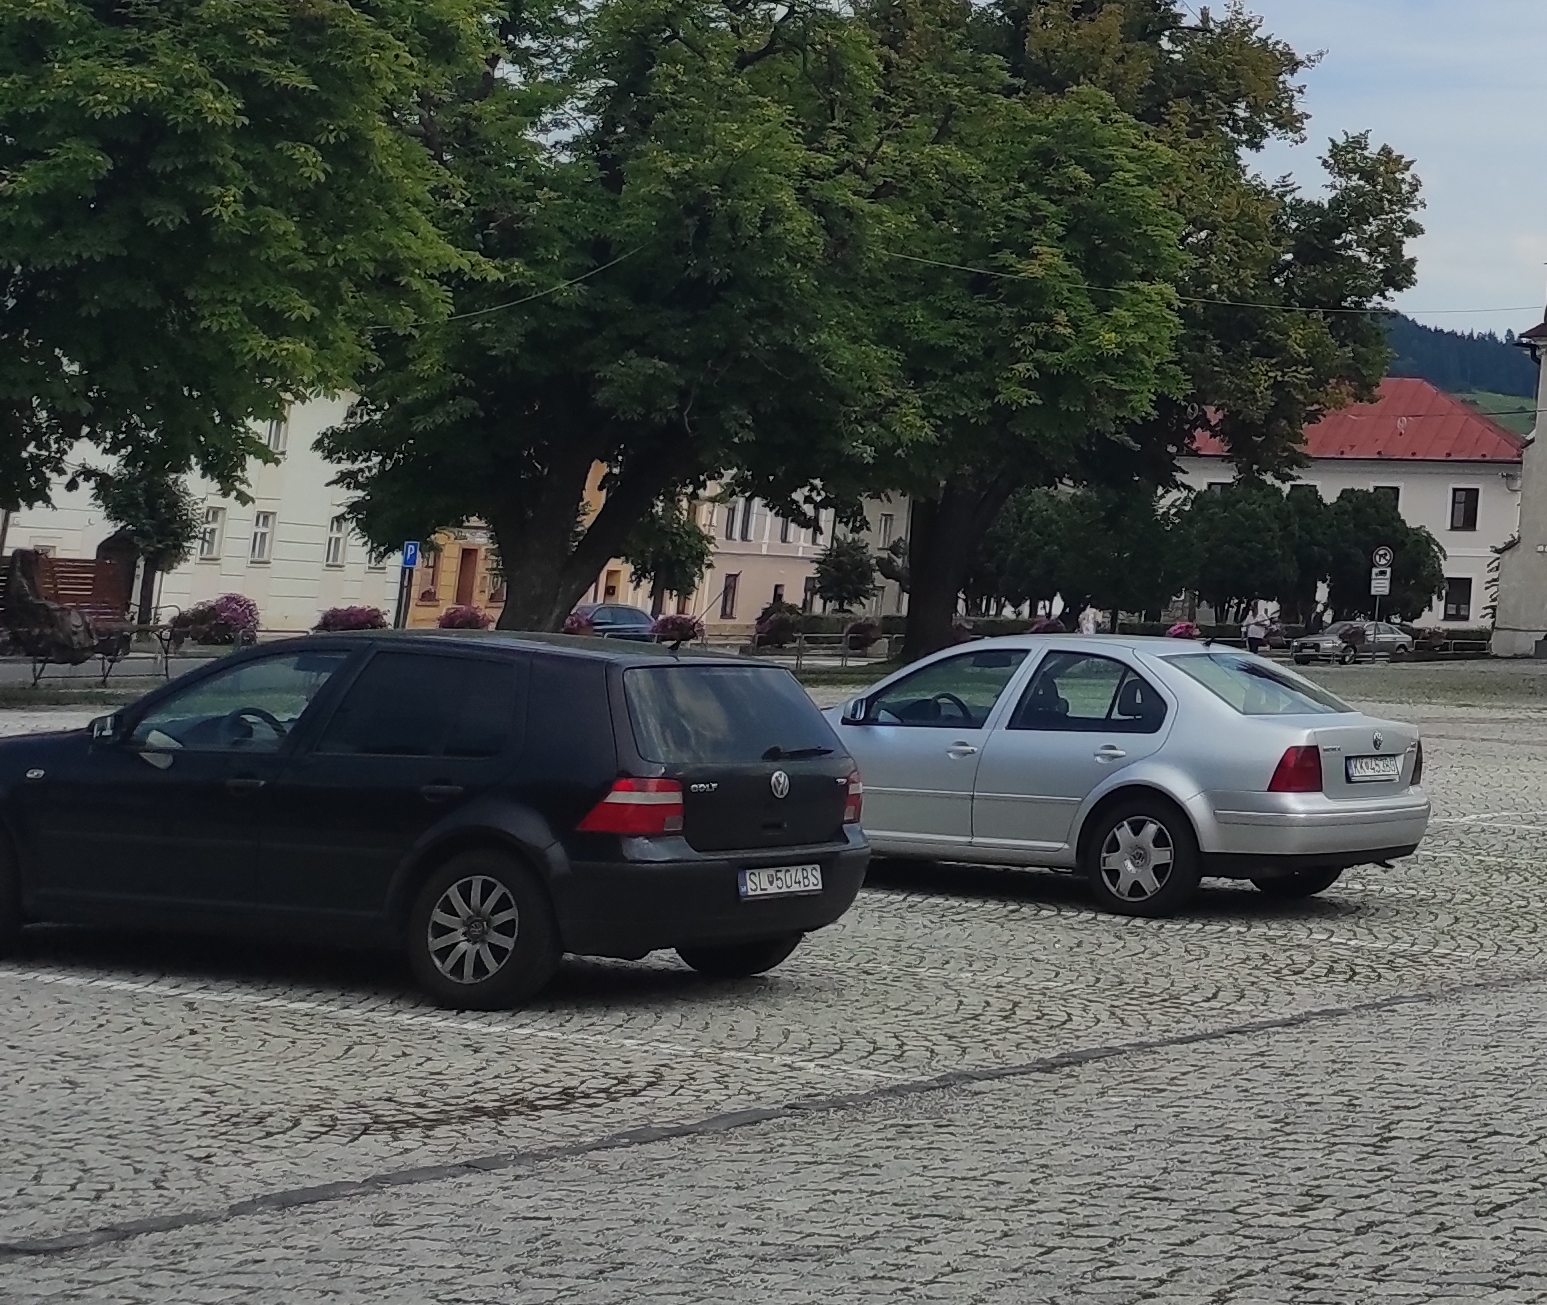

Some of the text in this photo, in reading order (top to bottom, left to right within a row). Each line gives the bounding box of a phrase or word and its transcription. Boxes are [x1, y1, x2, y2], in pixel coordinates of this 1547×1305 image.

[406, 544, 415, 561] P
[748, 866, 819, 892] SL 504BS
